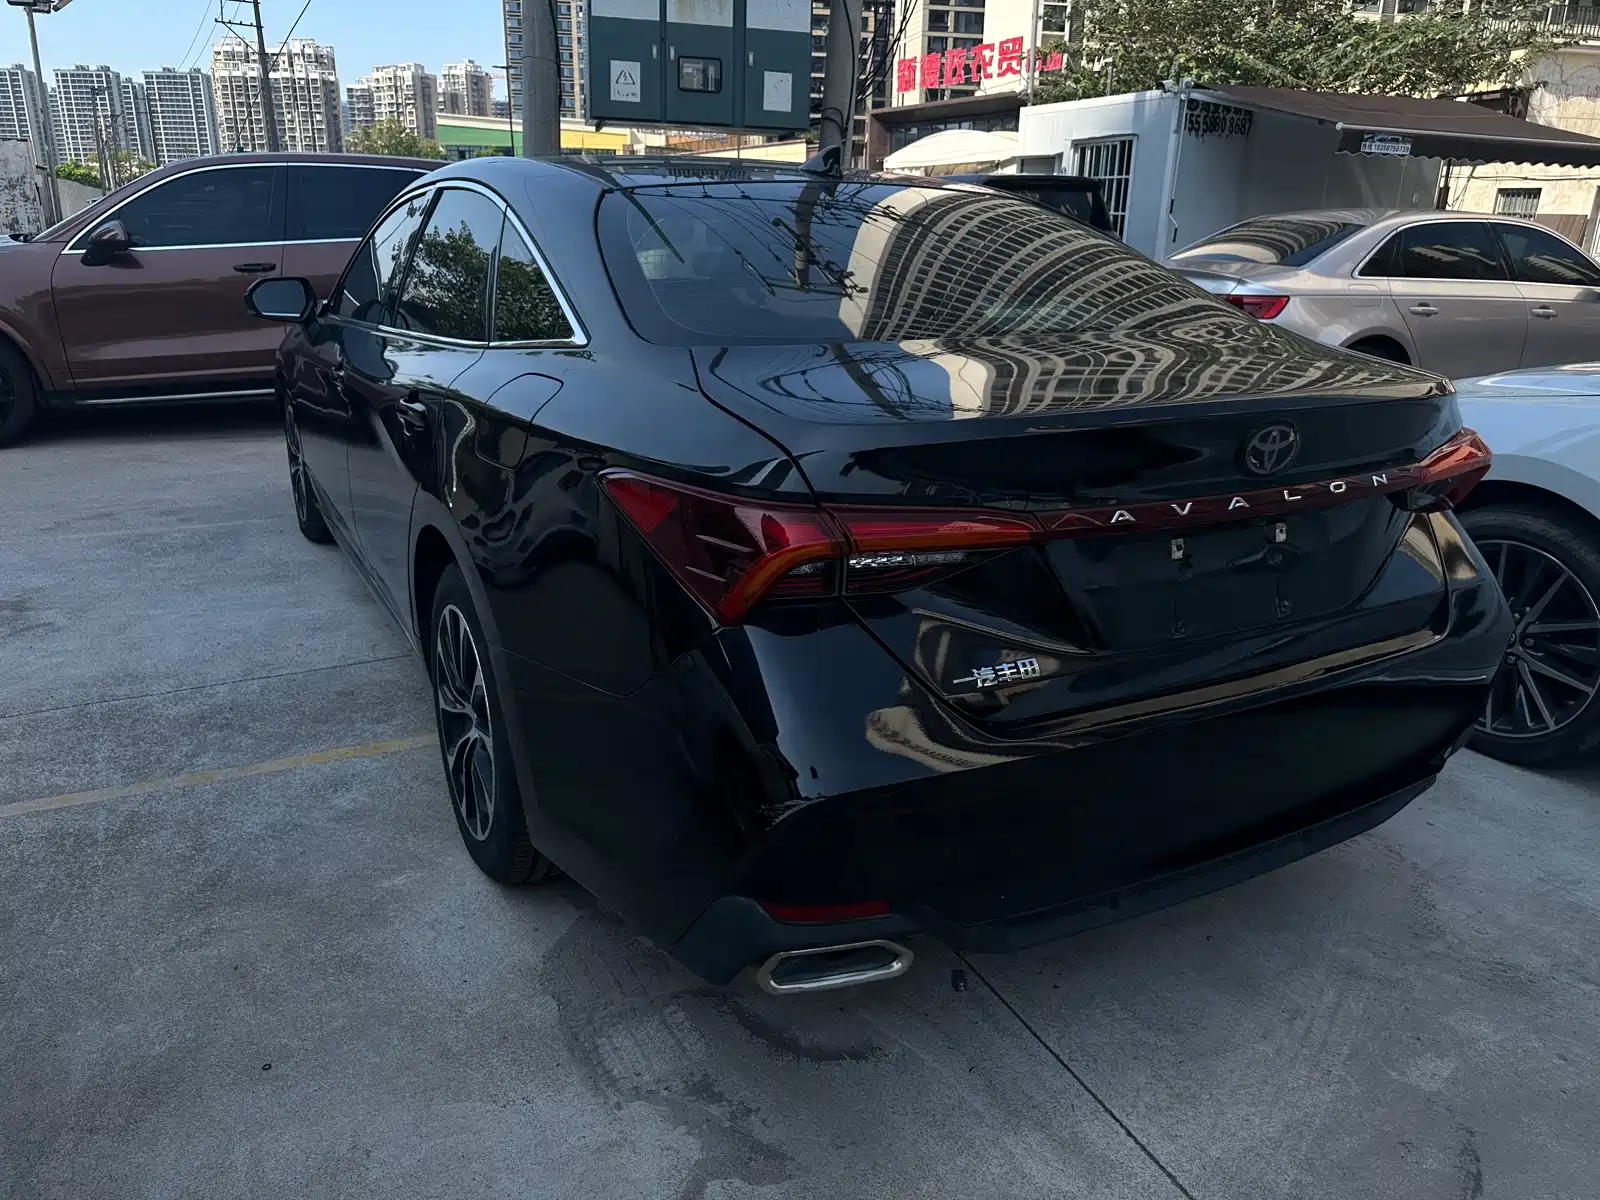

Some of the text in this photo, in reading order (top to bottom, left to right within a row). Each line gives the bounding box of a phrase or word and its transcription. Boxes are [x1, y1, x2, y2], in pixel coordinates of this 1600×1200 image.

[1110, 473, 1387, 523] AVALON
[952, 658, 1040, 688] 一汽丰田
